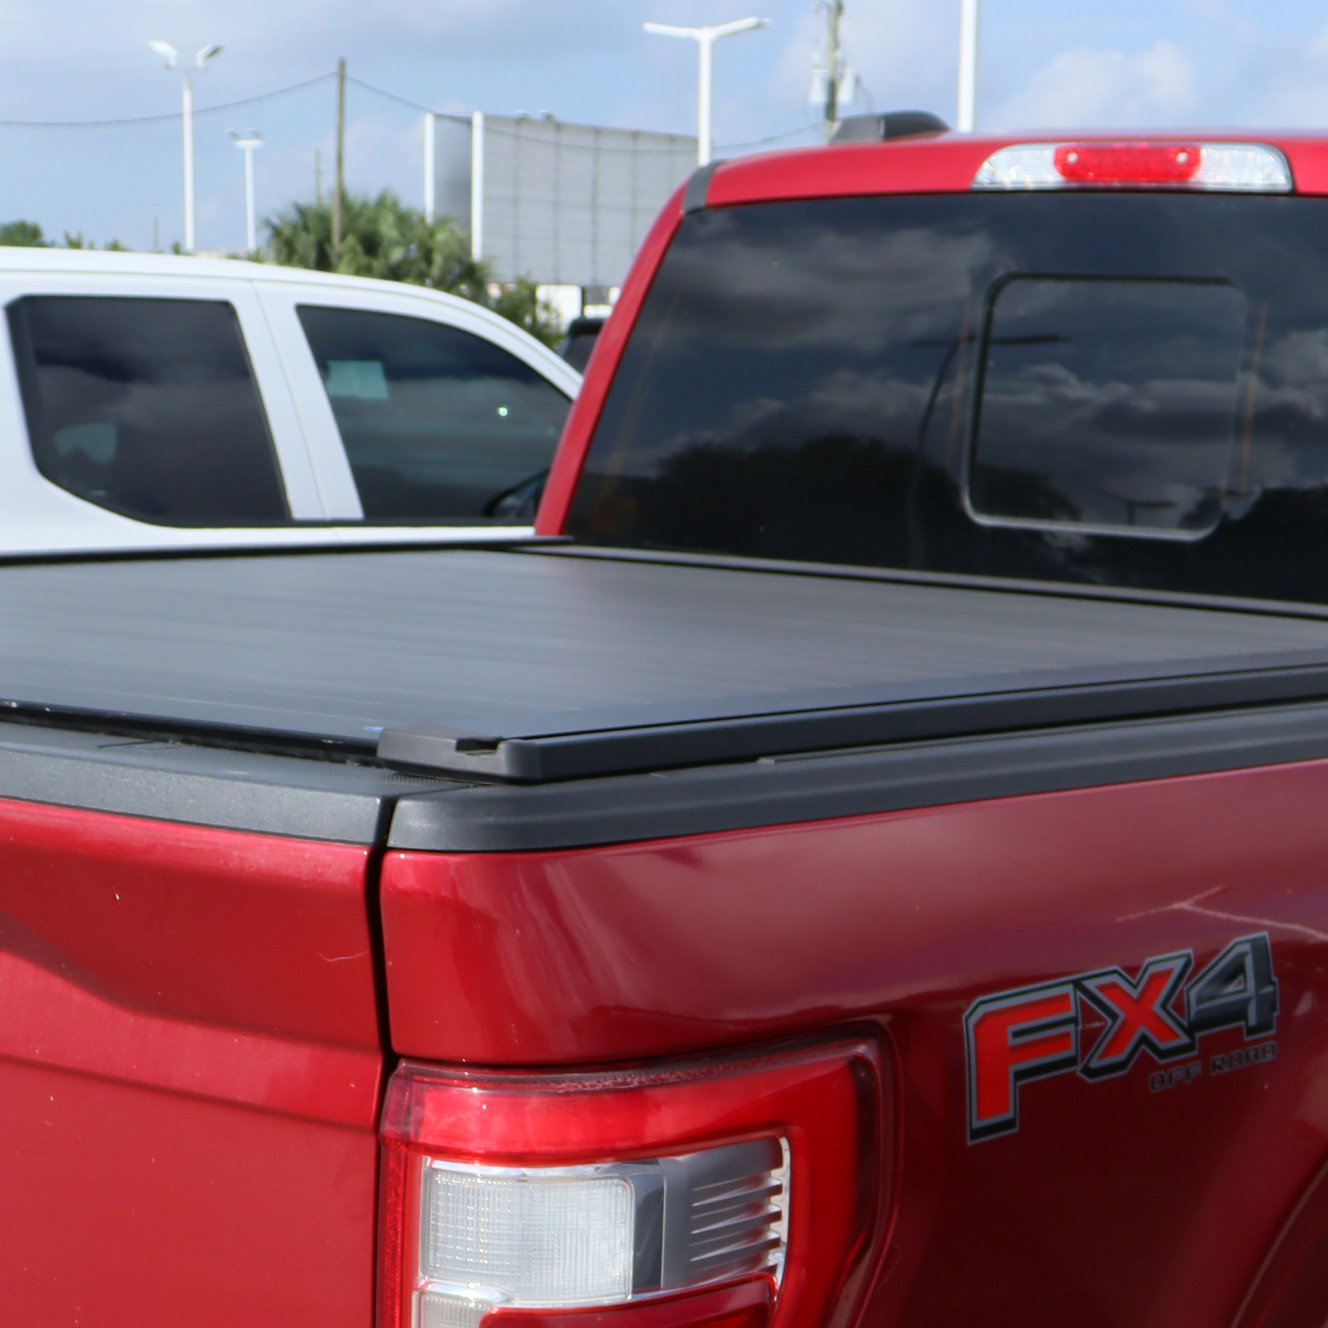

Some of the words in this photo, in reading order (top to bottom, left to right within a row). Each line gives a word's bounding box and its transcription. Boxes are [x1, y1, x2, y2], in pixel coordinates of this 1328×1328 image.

[962, 930, 1280, 1146] FX4
[1149, 1059, 1203, 1094] OFF
[1209, 1039, 1278, 1077] ROAD
